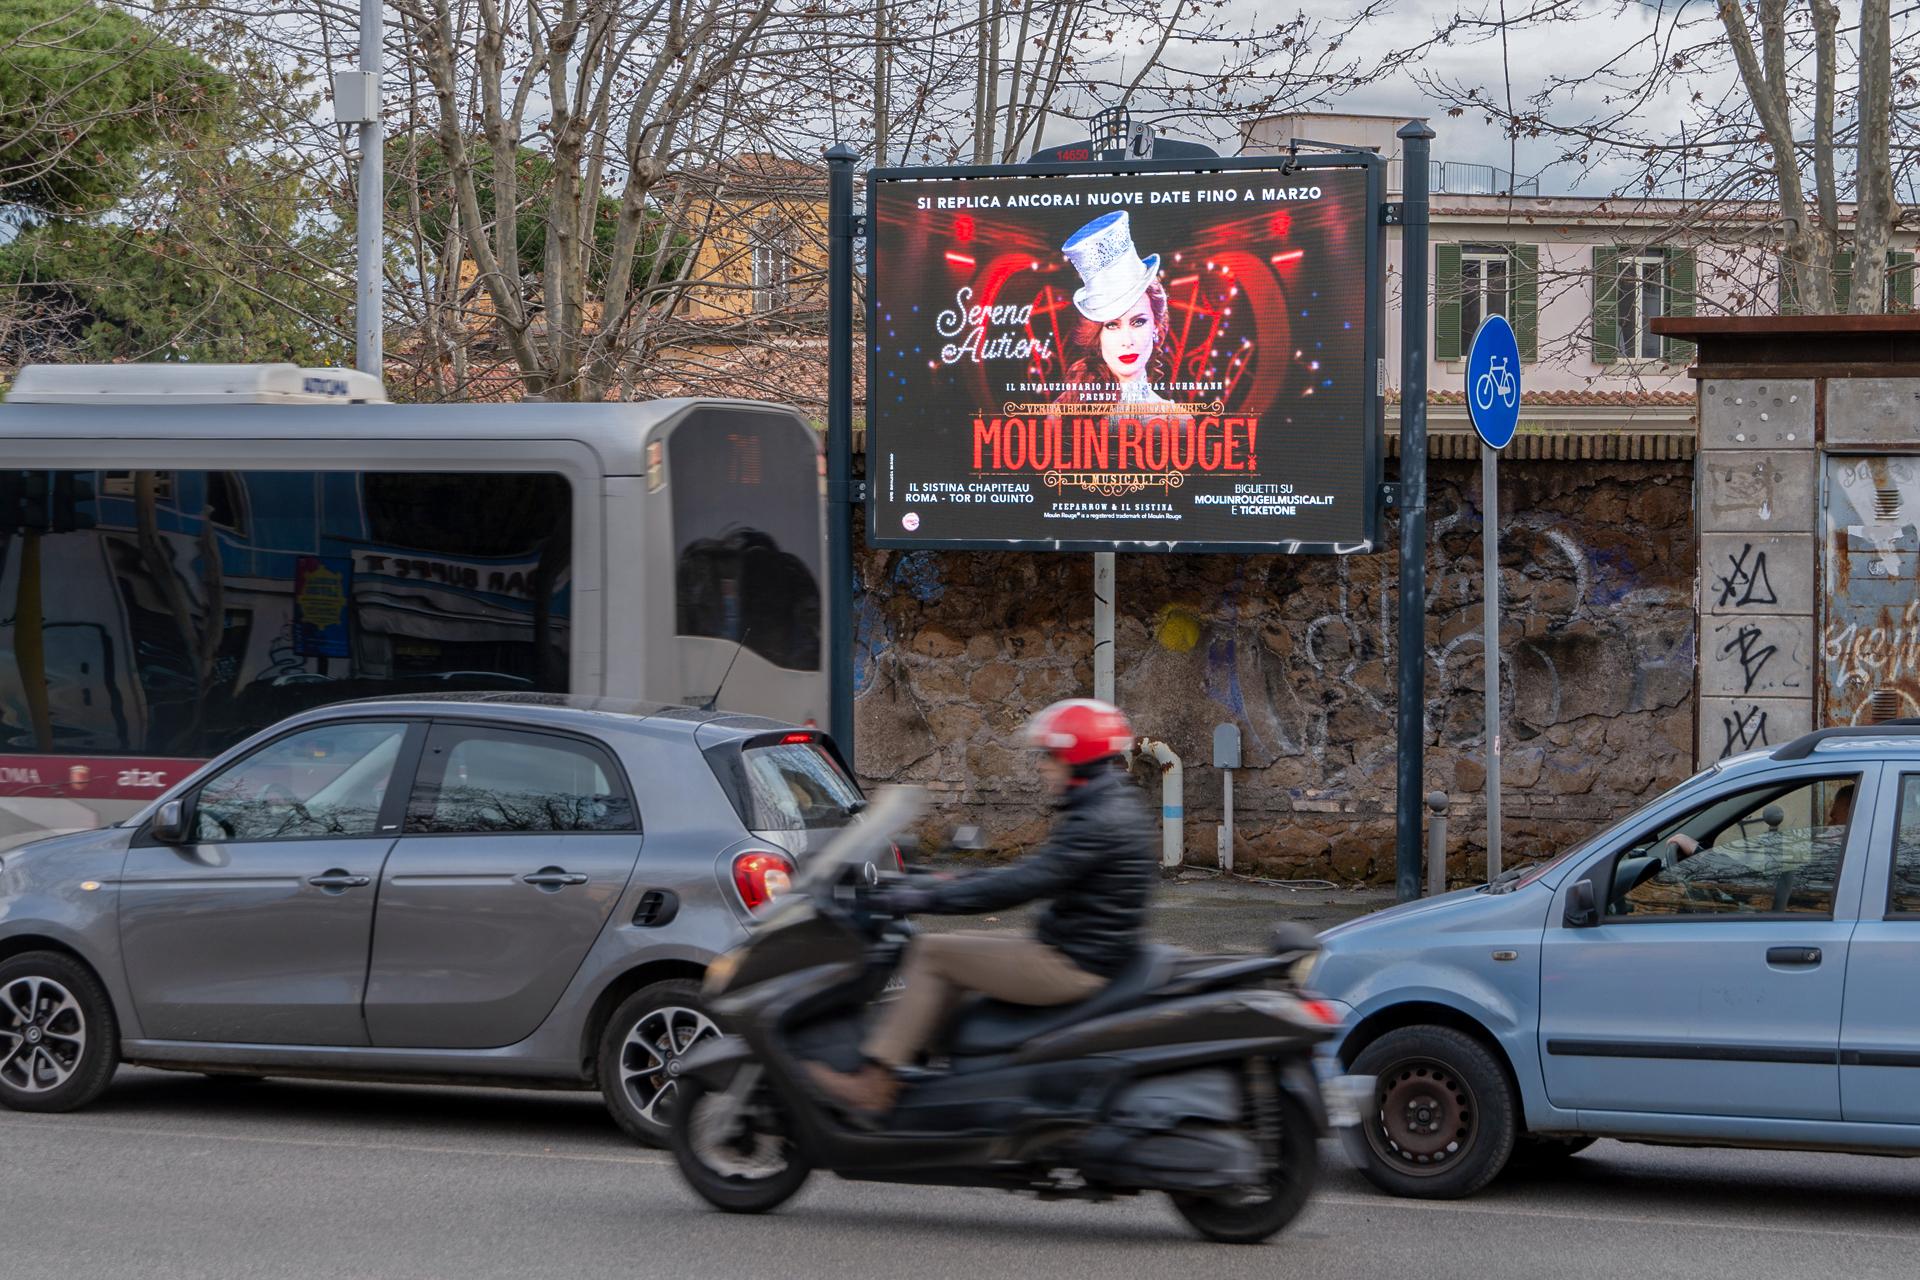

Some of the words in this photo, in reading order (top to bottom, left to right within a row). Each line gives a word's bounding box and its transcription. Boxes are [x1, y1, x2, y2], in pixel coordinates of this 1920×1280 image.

[1056, 149, 1088, 161] 14650
[917, 197, 931, 209] SI
[937, 195, 1001, 209] REPLICA
[1006, 194, 1080, 208] ANCORA!
[1087, 192, 1143, 206] NUOVE
[1150, 190, 1191, 204] DATE
[1197, 189, 1238, 203] FINO
[1243, 189, 1255, 201] A
[1261, 187, 1322, 201] MARZO
[936, 286, 1034, 337] Serena
[941, 325, 1054, 364] Autieri
[1006, 383, 1016, 391] IL
[1020, 382, 1101, 391] RIVOLUZIONARIO
[1169, 382, 1223, 391] LUHRMANN
[1079, 392, 1117, 401] PRENDE
[972, 417, 1109, 471] MOULIN
[1118, 417, 1259, 471] ROUGE!
[909, 483, 919, 492] IL
[922, 483, 965, 492] SISTINA
[968, 483, 1030, 493] CHAPITEAU
[1234, 484, 1278, 494] BIGLIETTI
[1280, 484, 1293, 494] SU
[905, 494, 938, 503] ROMA
[949, 494, 971, 503] TOR
[975, 494, 986, 503] DI
[990, 494, 1034, 503] QUINTO
[1194, 495, 1334, 505] MOULINROUGEILMUSICAL.IT
[1052, 503, 1108, 511] PEEPARROW
[1111, 503, 1118, 511] &
[1121, 503, 1131, 511] IL
[1134, 503, 1173, 511] SISTINA
[1231, 505, 1238, 515] E
[1239, 505, 1297, 515] TICKETONE
[116, 768, 168, 788] atac
